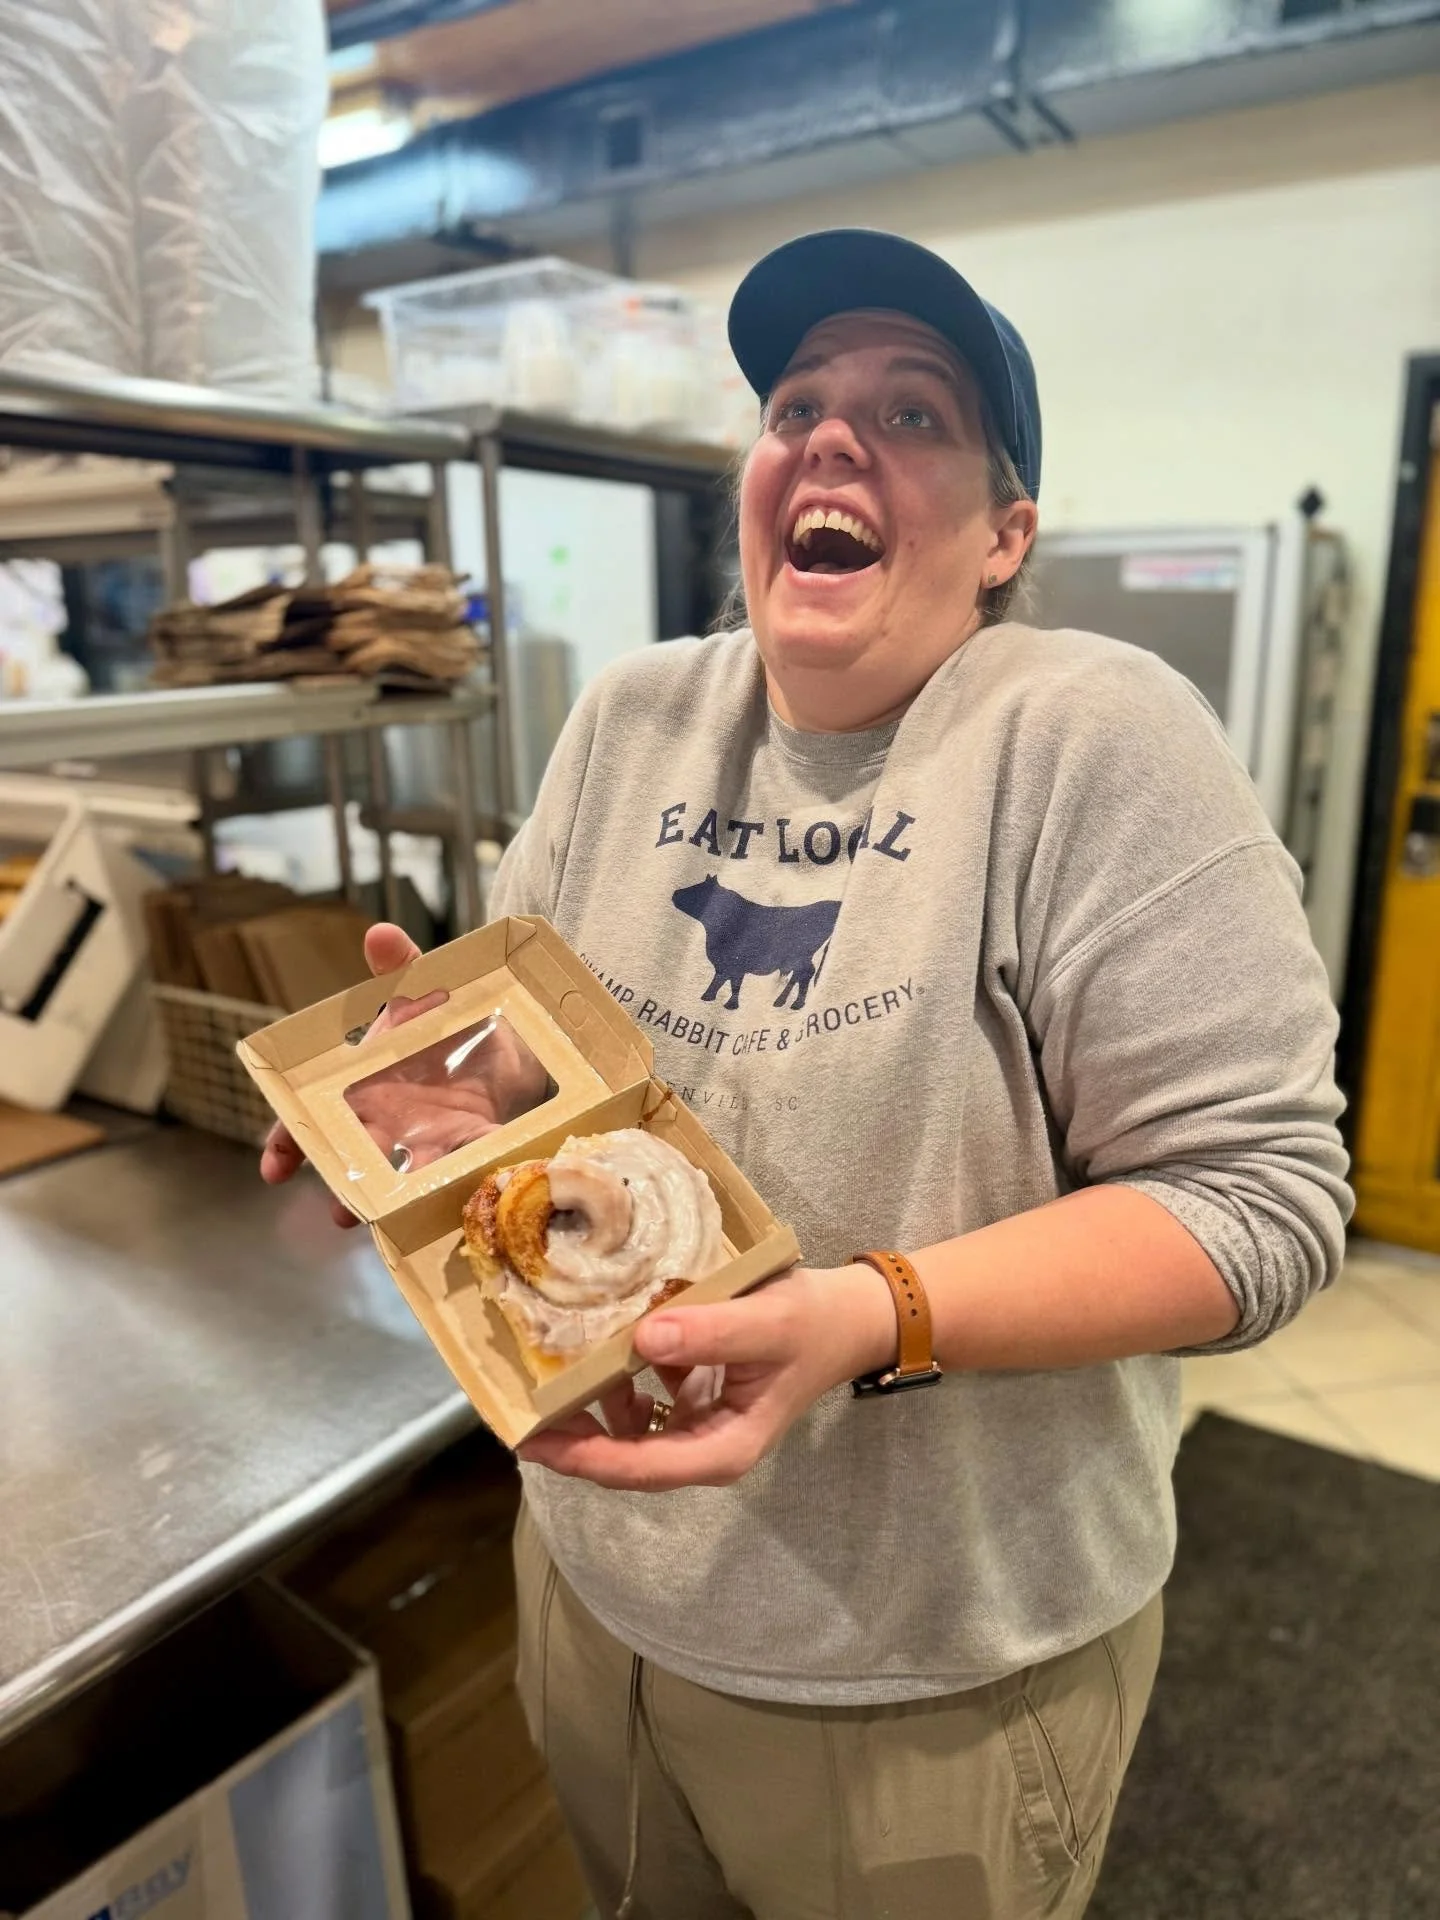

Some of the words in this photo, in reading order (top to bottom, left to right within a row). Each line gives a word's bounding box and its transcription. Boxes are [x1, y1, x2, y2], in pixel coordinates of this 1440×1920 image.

[655, 802, 765, 860] EAT
[637, 998, 731, 1054] RABBIT
[776, 1028, 790, 1051] &
